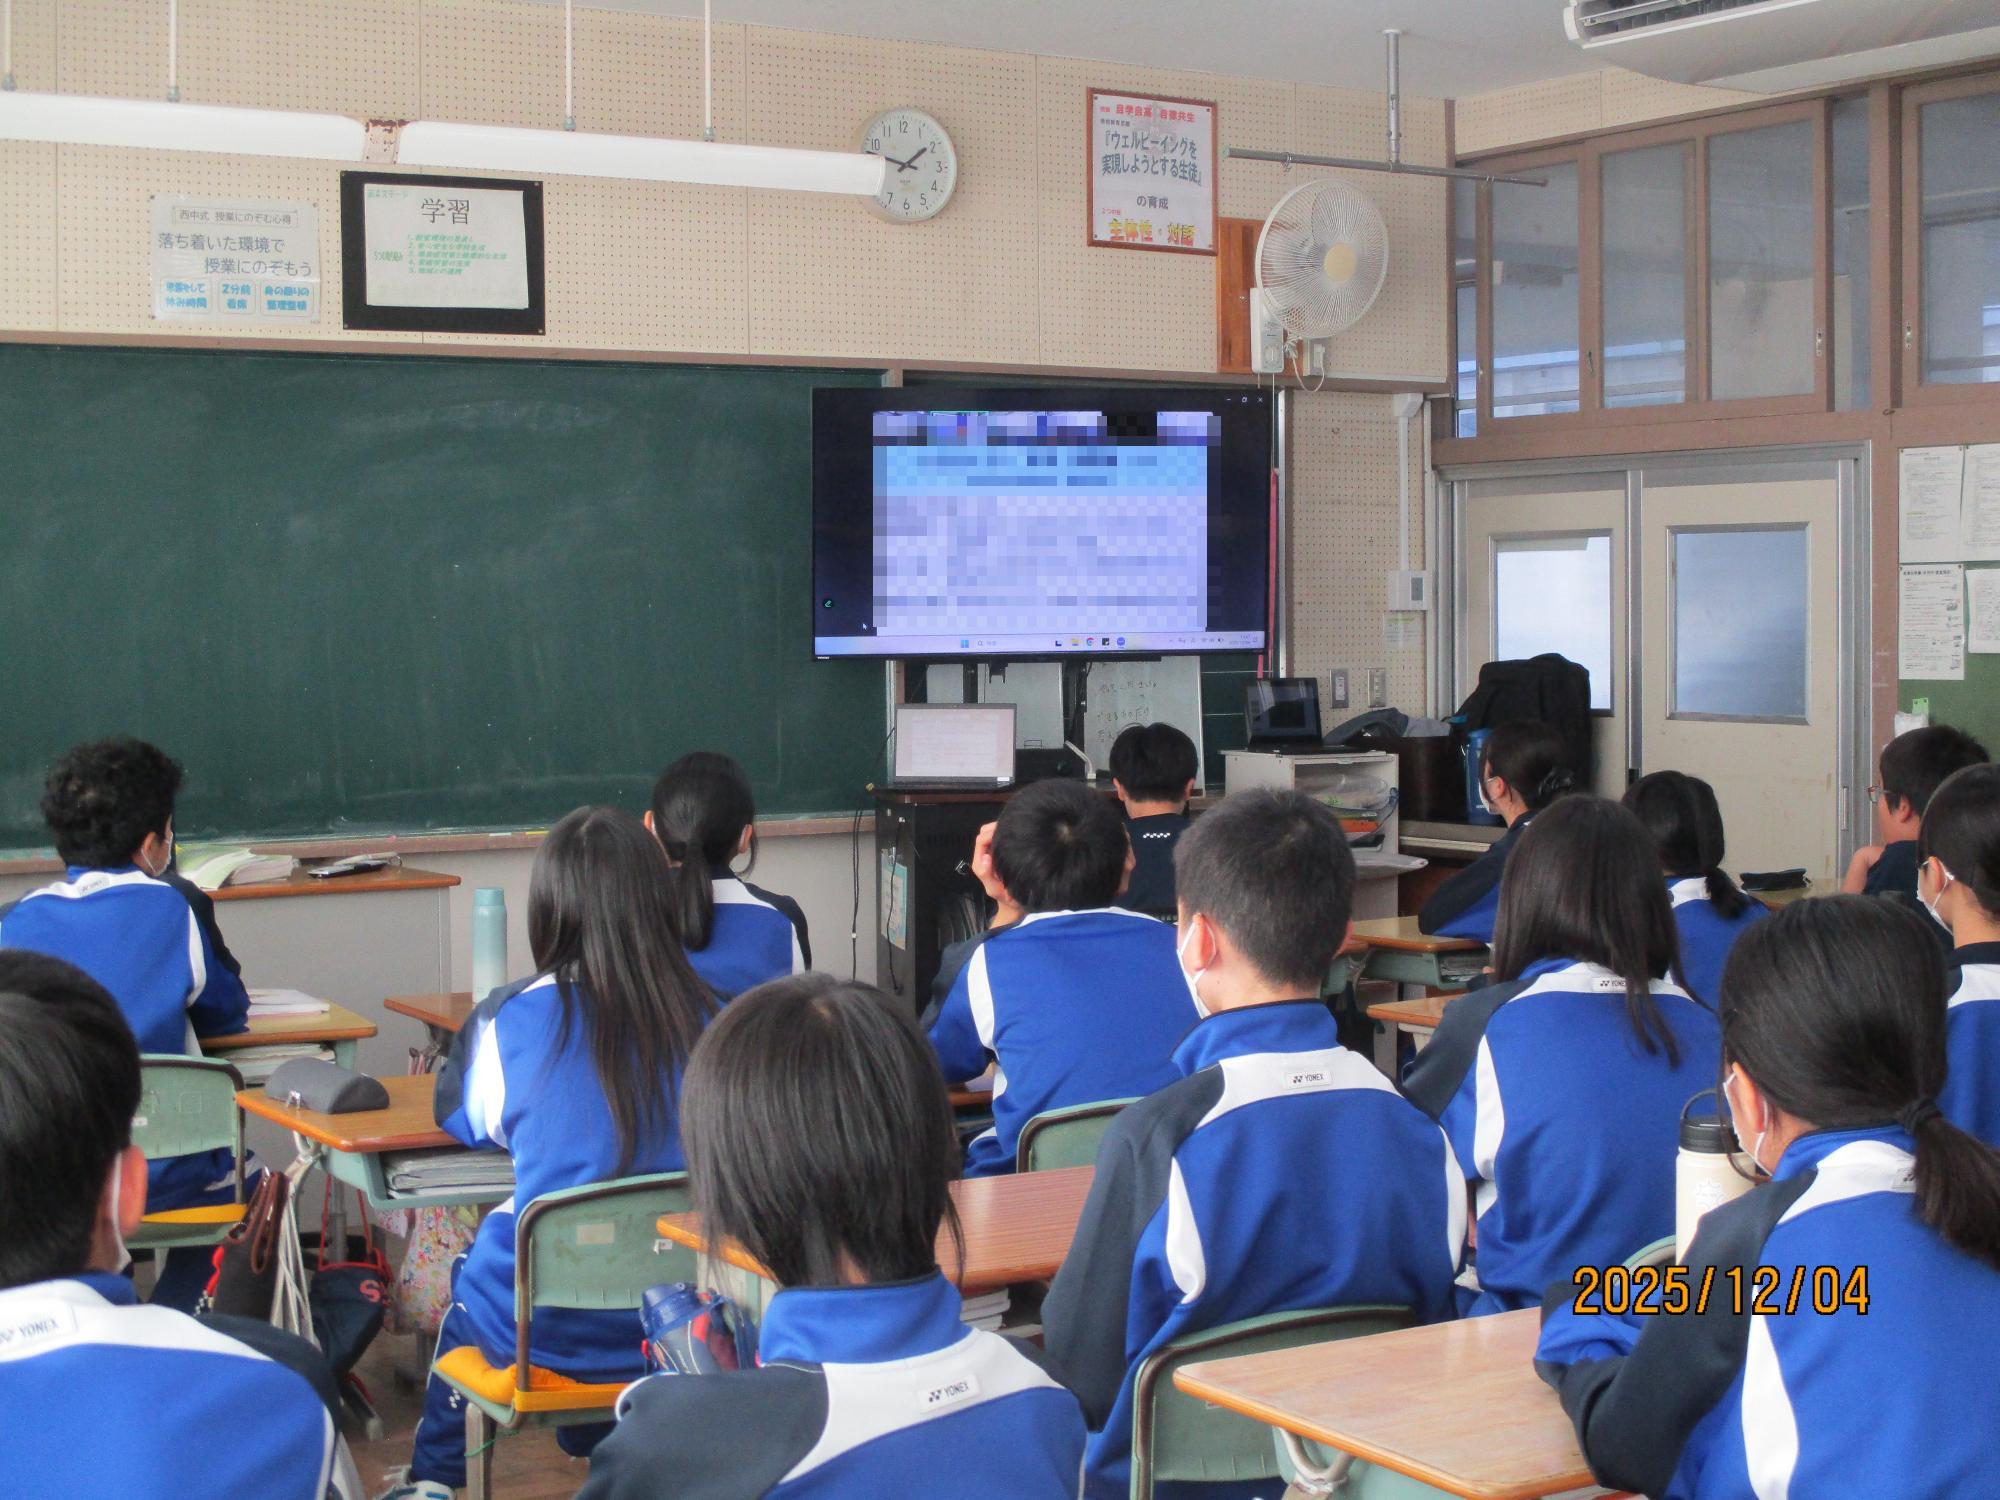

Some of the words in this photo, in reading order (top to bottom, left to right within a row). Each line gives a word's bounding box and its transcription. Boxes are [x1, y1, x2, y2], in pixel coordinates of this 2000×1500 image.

[883, 124, 891, 137] 11
[899, 120, 909, 134] 12
[871, 138, 881, 151] 10
[929, 141, 937, 154] 2
[936, 160, 943, 174] 3
[930, 180, 938, 192] 4
[887, 192, 894, 205] 7
[903, 198, 910, 211] 6
[920, 193, 927, 206] 5
[1136, 195, 1169, 210] の育成
[421, 198, 470, 225] 学習
[158, 232, 285, 254] 落ち着いた環境で
[204, 256, 312, 277] 授業にのぞもう
[1305, 1073, 1324, 1082] YONEX
[944, 1381, 969, 1398] YONEX
